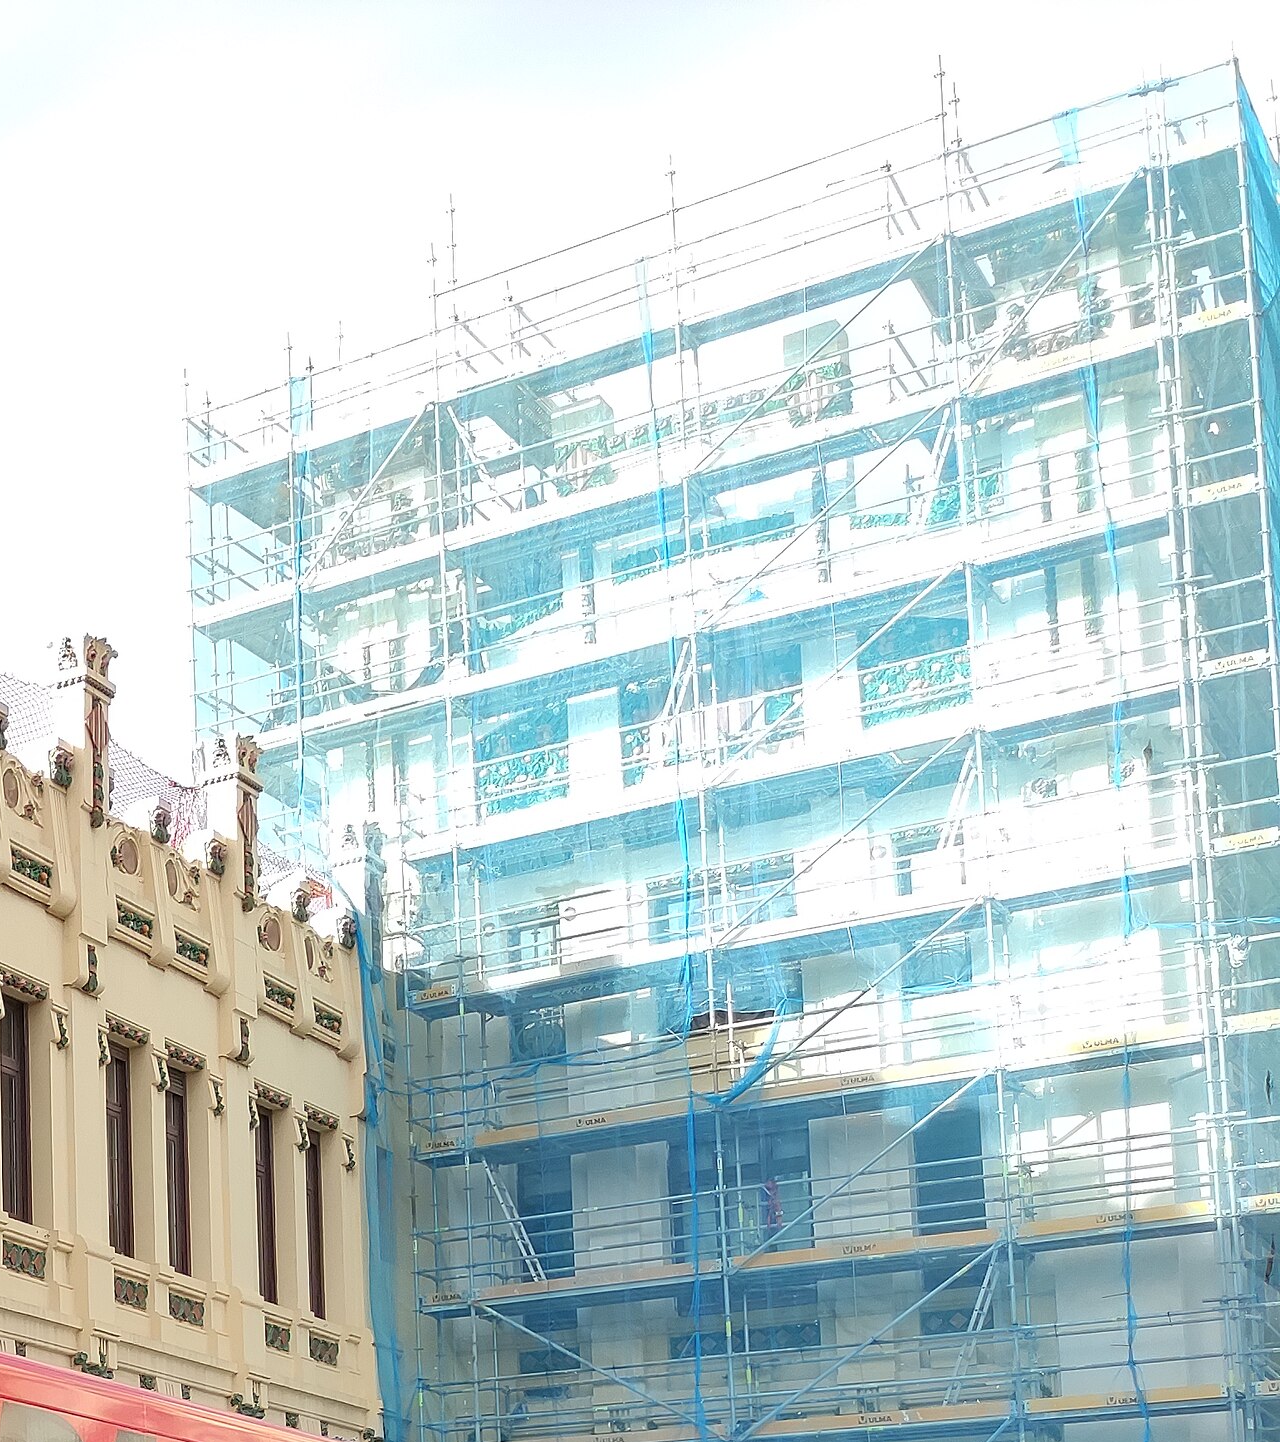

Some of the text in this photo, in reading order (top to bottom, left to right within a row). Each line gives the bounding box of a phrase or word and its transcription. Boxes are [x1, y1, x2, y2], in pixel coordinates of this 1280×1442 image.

[1226, 655, 1254, 667] ULMA
[430, 989, 450, 999] ULMA
[1093, 1038, 1120, 1048] ULMA
[850, 1075, 875, 1084] ULMA
[585, 1116, 606, 1125] ULMA
[432, 1140, 454, 1149] ULMA
[441, 1294, 462, 1302] ULMA
[869, 1415, 892, 1424] ULMA
